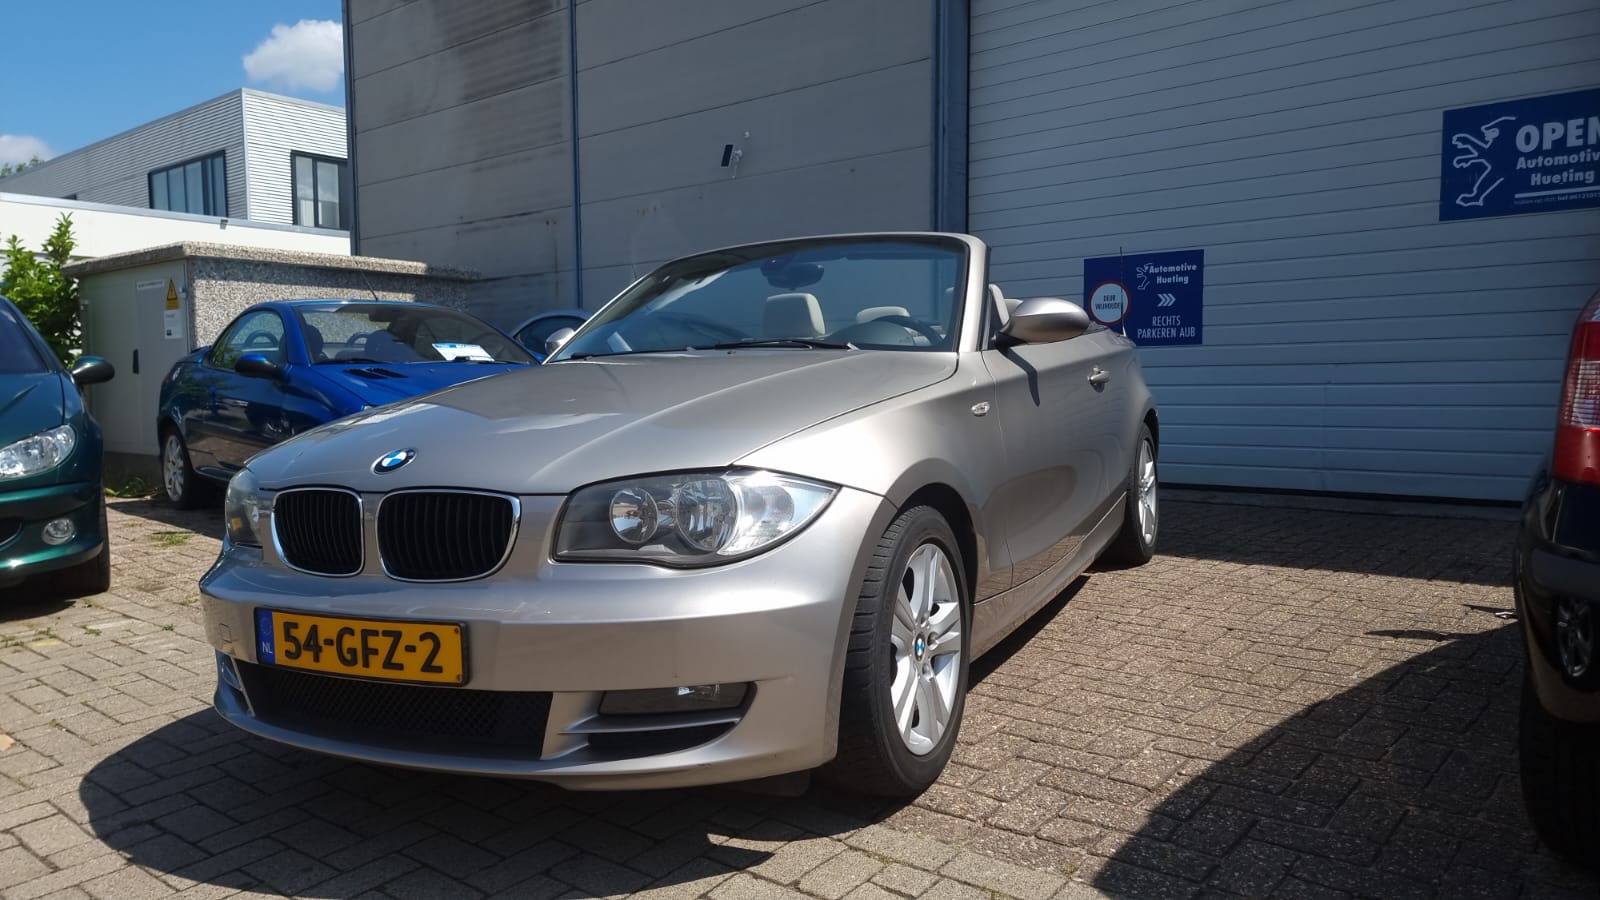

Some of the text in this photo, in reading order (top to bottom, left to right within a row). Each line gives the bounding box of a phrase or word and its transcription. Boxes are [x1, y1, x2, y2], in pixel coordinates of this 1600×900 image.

[1515, 116, 1600, 153] OPEN
[1530, 169, 1595, 186] Hueting
[1149, 262, 1197, 273] Automotive
[1156, 275, 1189, 285] Hueting
[1095, 301, 1122, 310] VRIJHOUDE
[1152, 315, 1181, 327] RECHTS
[1137, 326, 1196, 339] PARKEREN AUB
[262, 640, 273, 654] NL
[282, 621, 444, 674] 54-GFZ-2
